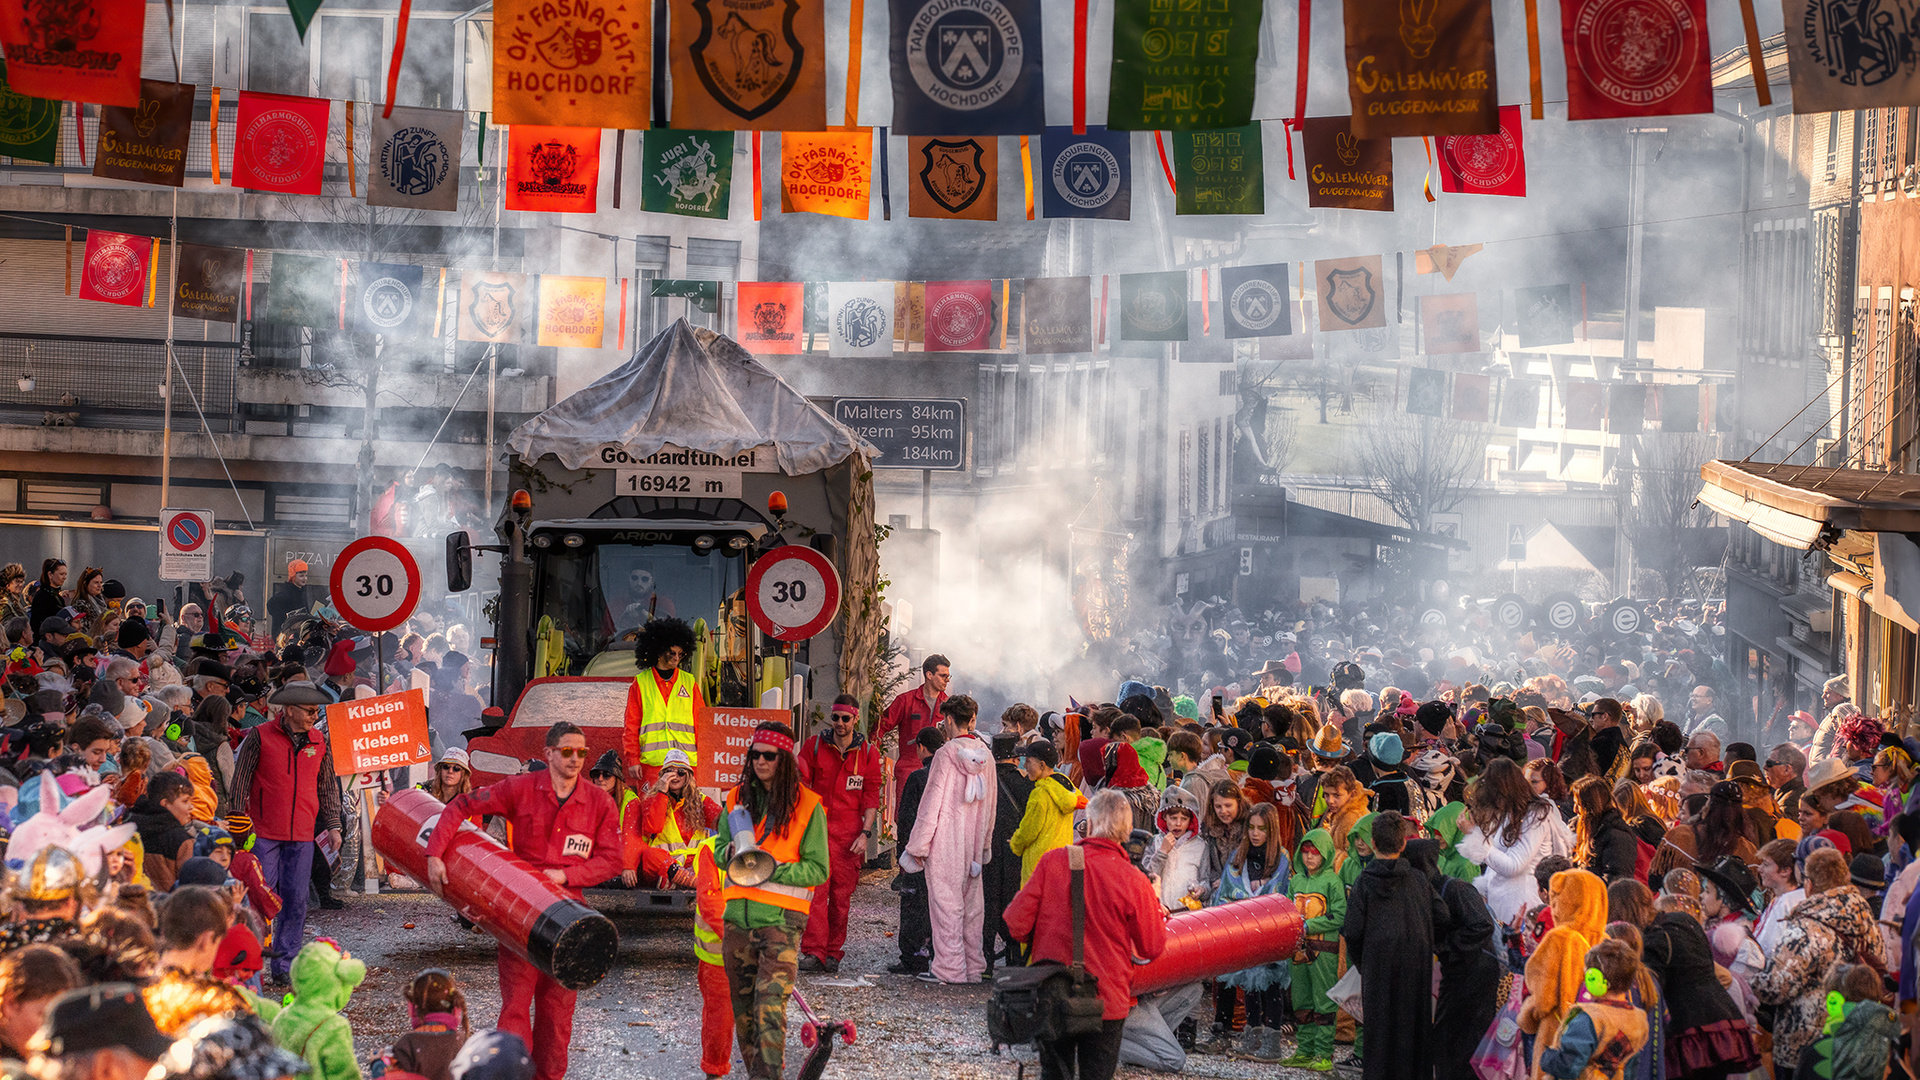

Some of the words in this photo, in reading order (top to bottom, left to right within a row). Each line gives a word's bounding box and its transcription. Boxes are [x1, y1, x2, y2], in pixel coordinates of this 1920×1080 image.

[507, 26, 533, 60] OK
[529, 0, 635, 64] FASNACHT
[508, 71, 636, 94] HOCHDORF
[1599, 74, 1680, 102] HOCHDORF
[929, 81, 1004, 106] HOCHDORF
[1367, 100, 1480, 116] GUGGENMUSIK
[380, 141, 392, 178] MARTINI
[410, 126, 437, 139] ZUNFT
[436, 141, 450, 186] HOCHDORF
[660, 142, 688, 164] JURI
[1054, 144, 1118, 178] TAMBOURENGRUPPE
[106, 156, 176, 173] GUGGENMUSIK
[790, 160, 805, 179] OK
[802, 147, 862, 184] FASNACHT
[252, 166, 302, 183] HOCHDORF
[1460, 170, 1507, 186] HOCHDORF
[790, 184, 862, 200] HOCHDORF
[1066, 192, 1110, 206] HOCHDORF
[1318, 187, 1385, 199] GUGGENMUSIK
[94, 284, 130, 297] HOCHDORF
[1231, 281, 1280, 309] TAMBOURENGRUPPE
[556, 294, 598, 322] FASNACHT
[545, 324, 598, 334] HOCHDORF
[836, 308, 844, 337] MARTINI
[1241, 316, 1274, 328] HOCHDORF
[939, 332, 975, 344] HOCHDORF
[844, 405, 903, 420] Malters
[912, 405, 954, 420] 84km
[852, 426, 894, 438] uzern
[911, 425, 954, 440] 95km
[902, 446, 953, 460] 184km
[628, 475, 690, 492] 16942
[705, 480, 723, 492] m
[612, 532, 673, 541] ARION
[1237, 534, 1280, 543] RESTAURANT
[286, 551, 324, 566] PIZZA
[356, 574, 394, 597] 30
[772, 580, 807, 603] 30
[348, 700, 404, 720] Kleben
[362, 716, 392, 733] und
[352, 733, 409, 752] Kleben
[356, 751, 409, 768] lassen
